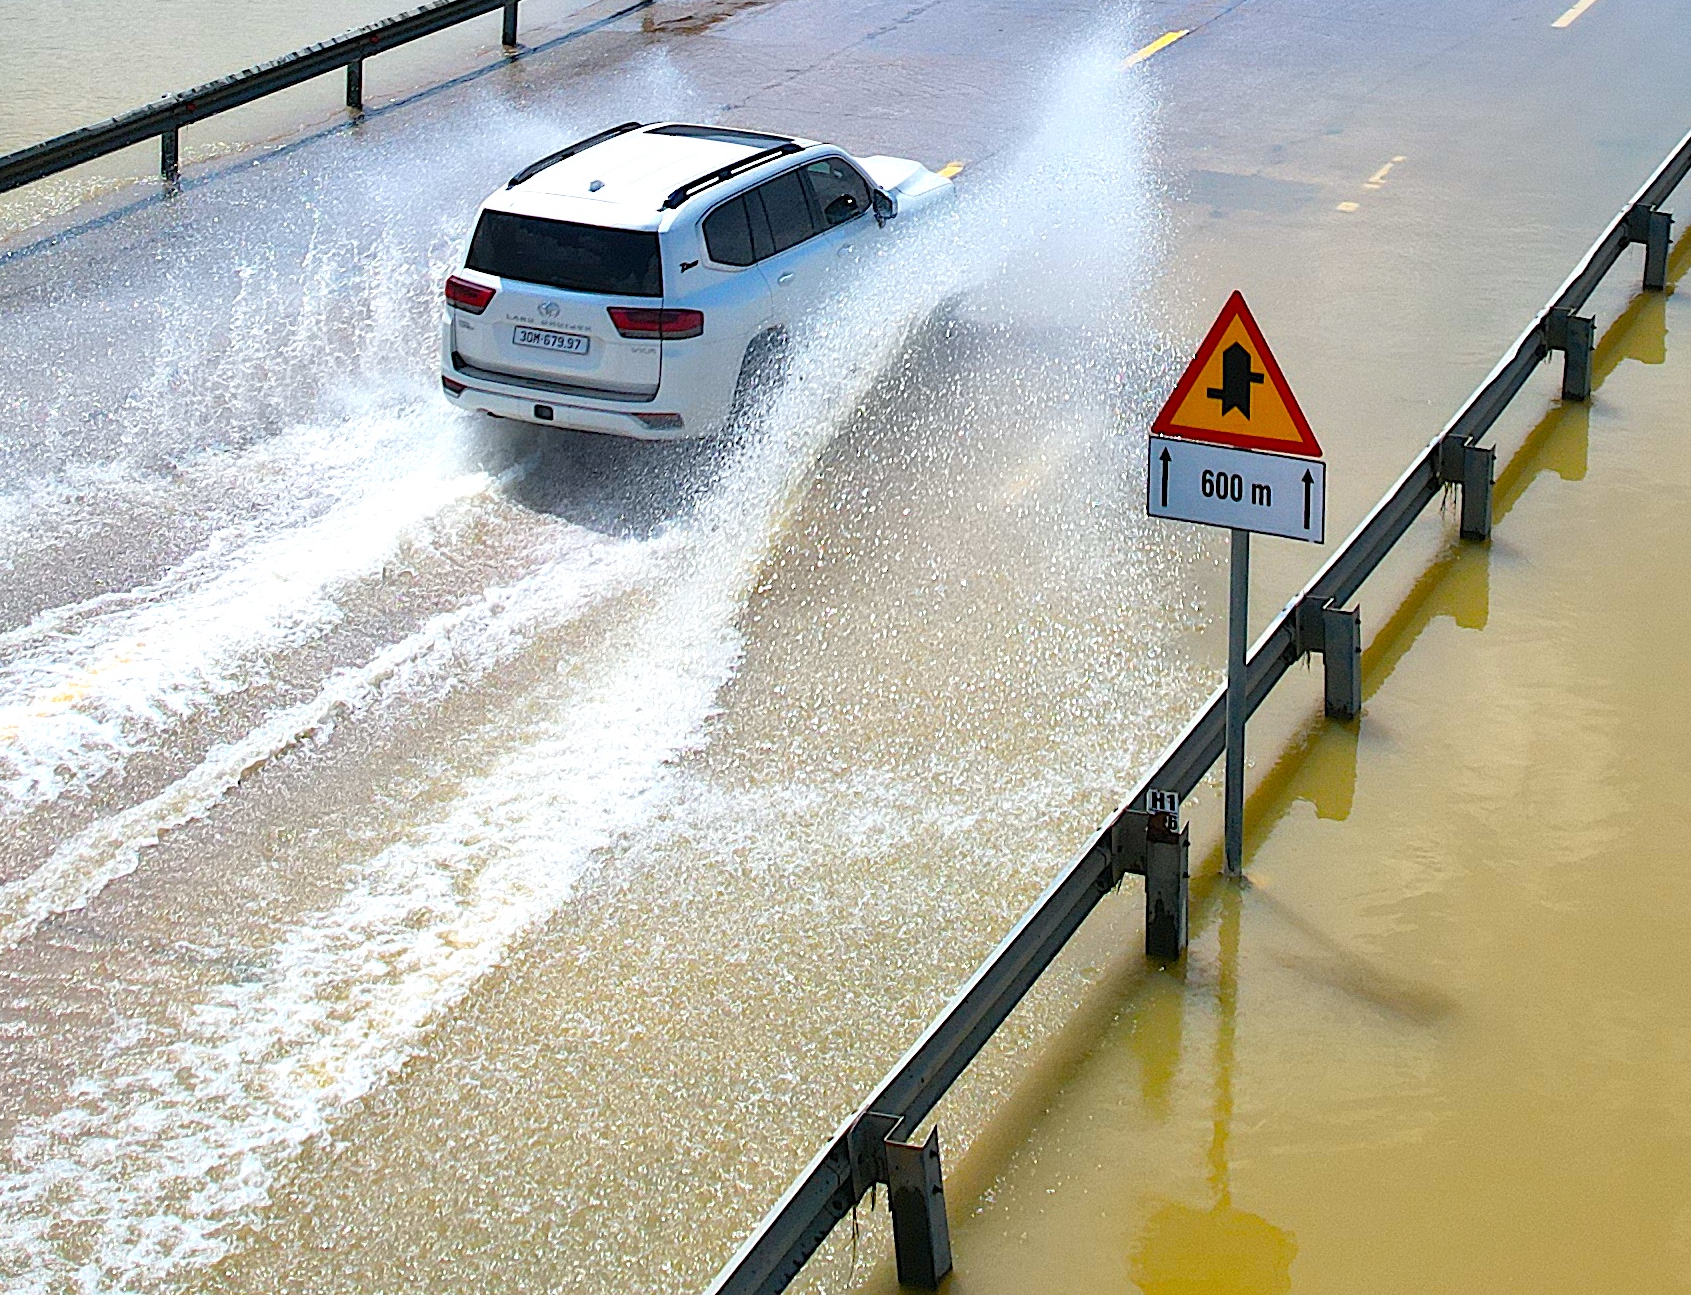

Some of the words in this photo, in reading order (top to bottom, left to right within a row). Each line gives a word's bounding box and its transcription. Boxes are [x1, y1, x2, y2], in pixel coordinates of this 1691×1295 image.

[1202, 469, 1243, 502] 600
[1252, 483, 1272, 507] m
[1152, 792, 1176, 811] H1
